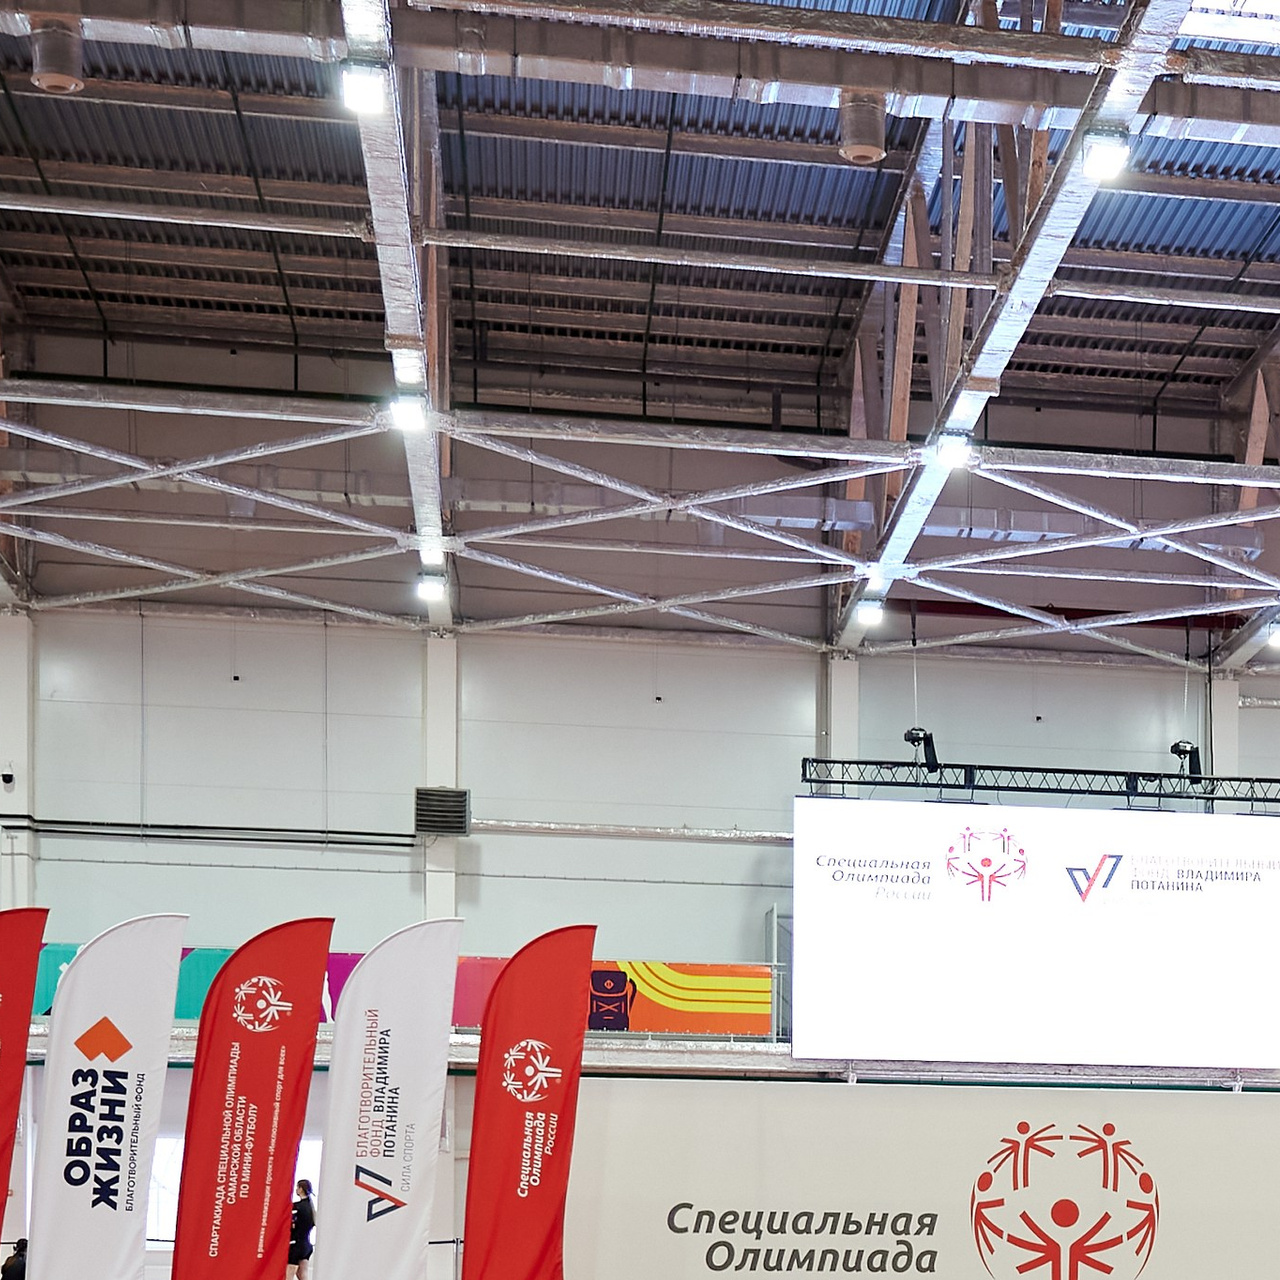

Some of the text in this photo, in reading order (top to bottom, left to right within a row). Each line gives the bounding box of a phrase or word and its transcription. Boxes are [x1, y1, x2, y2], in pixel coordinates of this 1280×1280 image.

[1131, 880, 1203, 892] ПОТАНИНА
[1177, 869, 1261, 881] ВЛАДИМИРА
[356, 1010, 378, 1157] БЛАГОТВОРИТЕЛЬНЫЙ
[370, 1029, 390, 1157] ФОНД ВЛАДИМИРА
[383, 1087, 399, 1157] ПОТАНИНА
[63, 1067, 99, 1187] ОБРАЗ
[91, 1069, 129, 1211] ЖИЗНИ
[126, 1074, 145, 1211] БЛАГОТВОРИТЕЛЬНЫЙ ФОНД
[209, 1042, 240, 1256] СПАРТАКИАДА СПЕЦИАЛЬНОЙ ОЛИМПИАДЫ
[227, 1096, 246, 1205] САМАРСКОЙ ОБЛАСТИ
[240, 1102, 258, 1199] ПО МИНИ-ФУТБОЛУ
[401, 1124, 415, 1192] СИЛА СПОРТА
[518, 1111, 535, 1197] Специальная
[529, 1113, 546, 1187] Олимпиада
[545, 1113, 558, 1155] России
[666, 1202, 939, 1240] Специальная
[706, 1238, 937, 1273] Олимпиада
